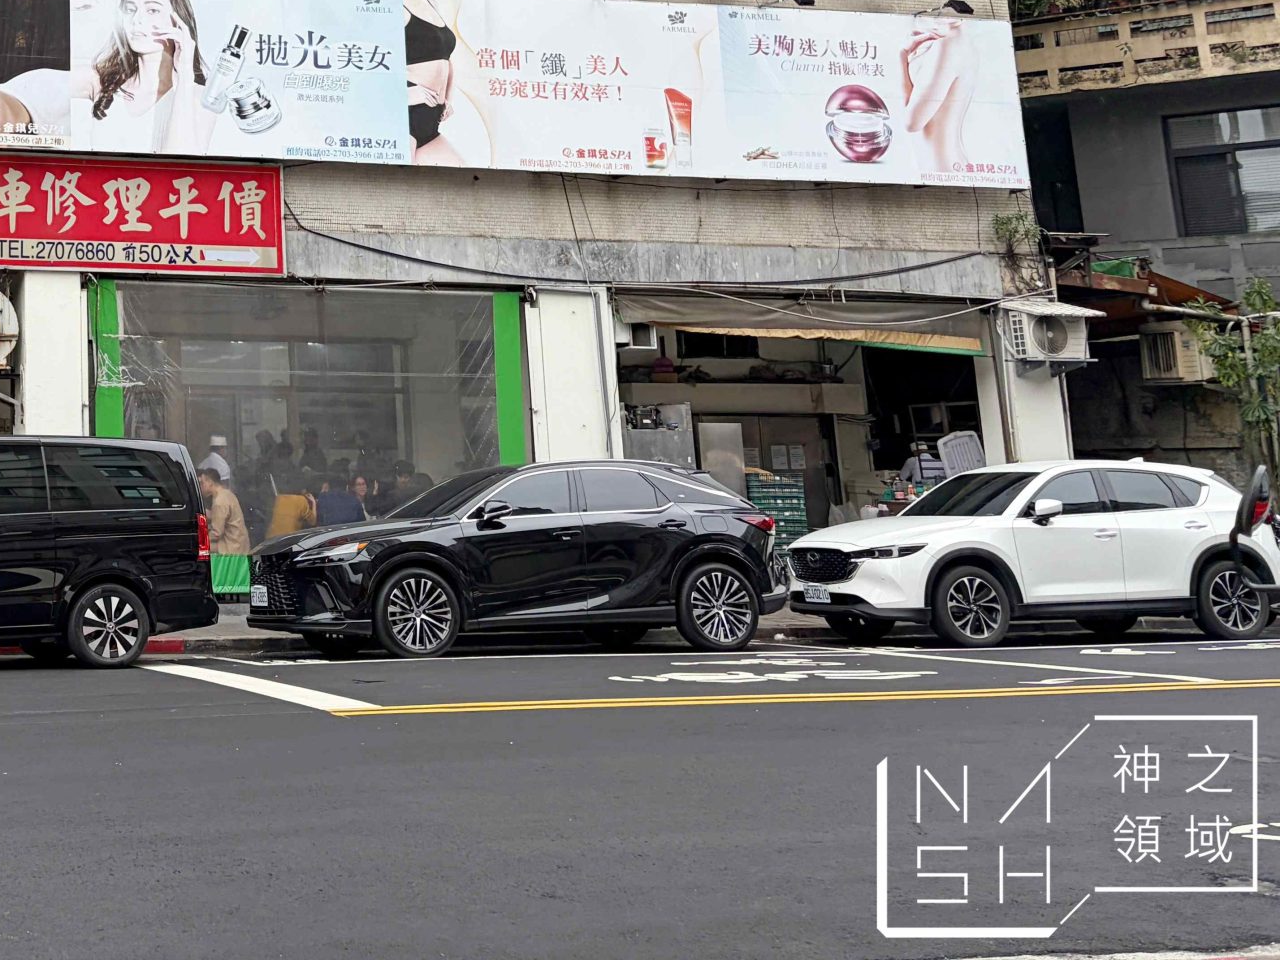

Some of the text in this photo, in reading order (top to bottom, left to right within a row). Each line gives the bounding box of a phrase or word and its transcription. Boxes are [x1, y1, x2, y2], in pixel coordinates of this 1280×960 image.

[356, 6, 393, 14] FARMELL
[740, 12, 781, 21] FARMELL
[662, 25, 696, 34] FARMELL
[256, 31, 392, 71] 拋光美女
[748, 34, 878, 60] 美胸迷人魅力
[780, 59, 824, 73] Charm
